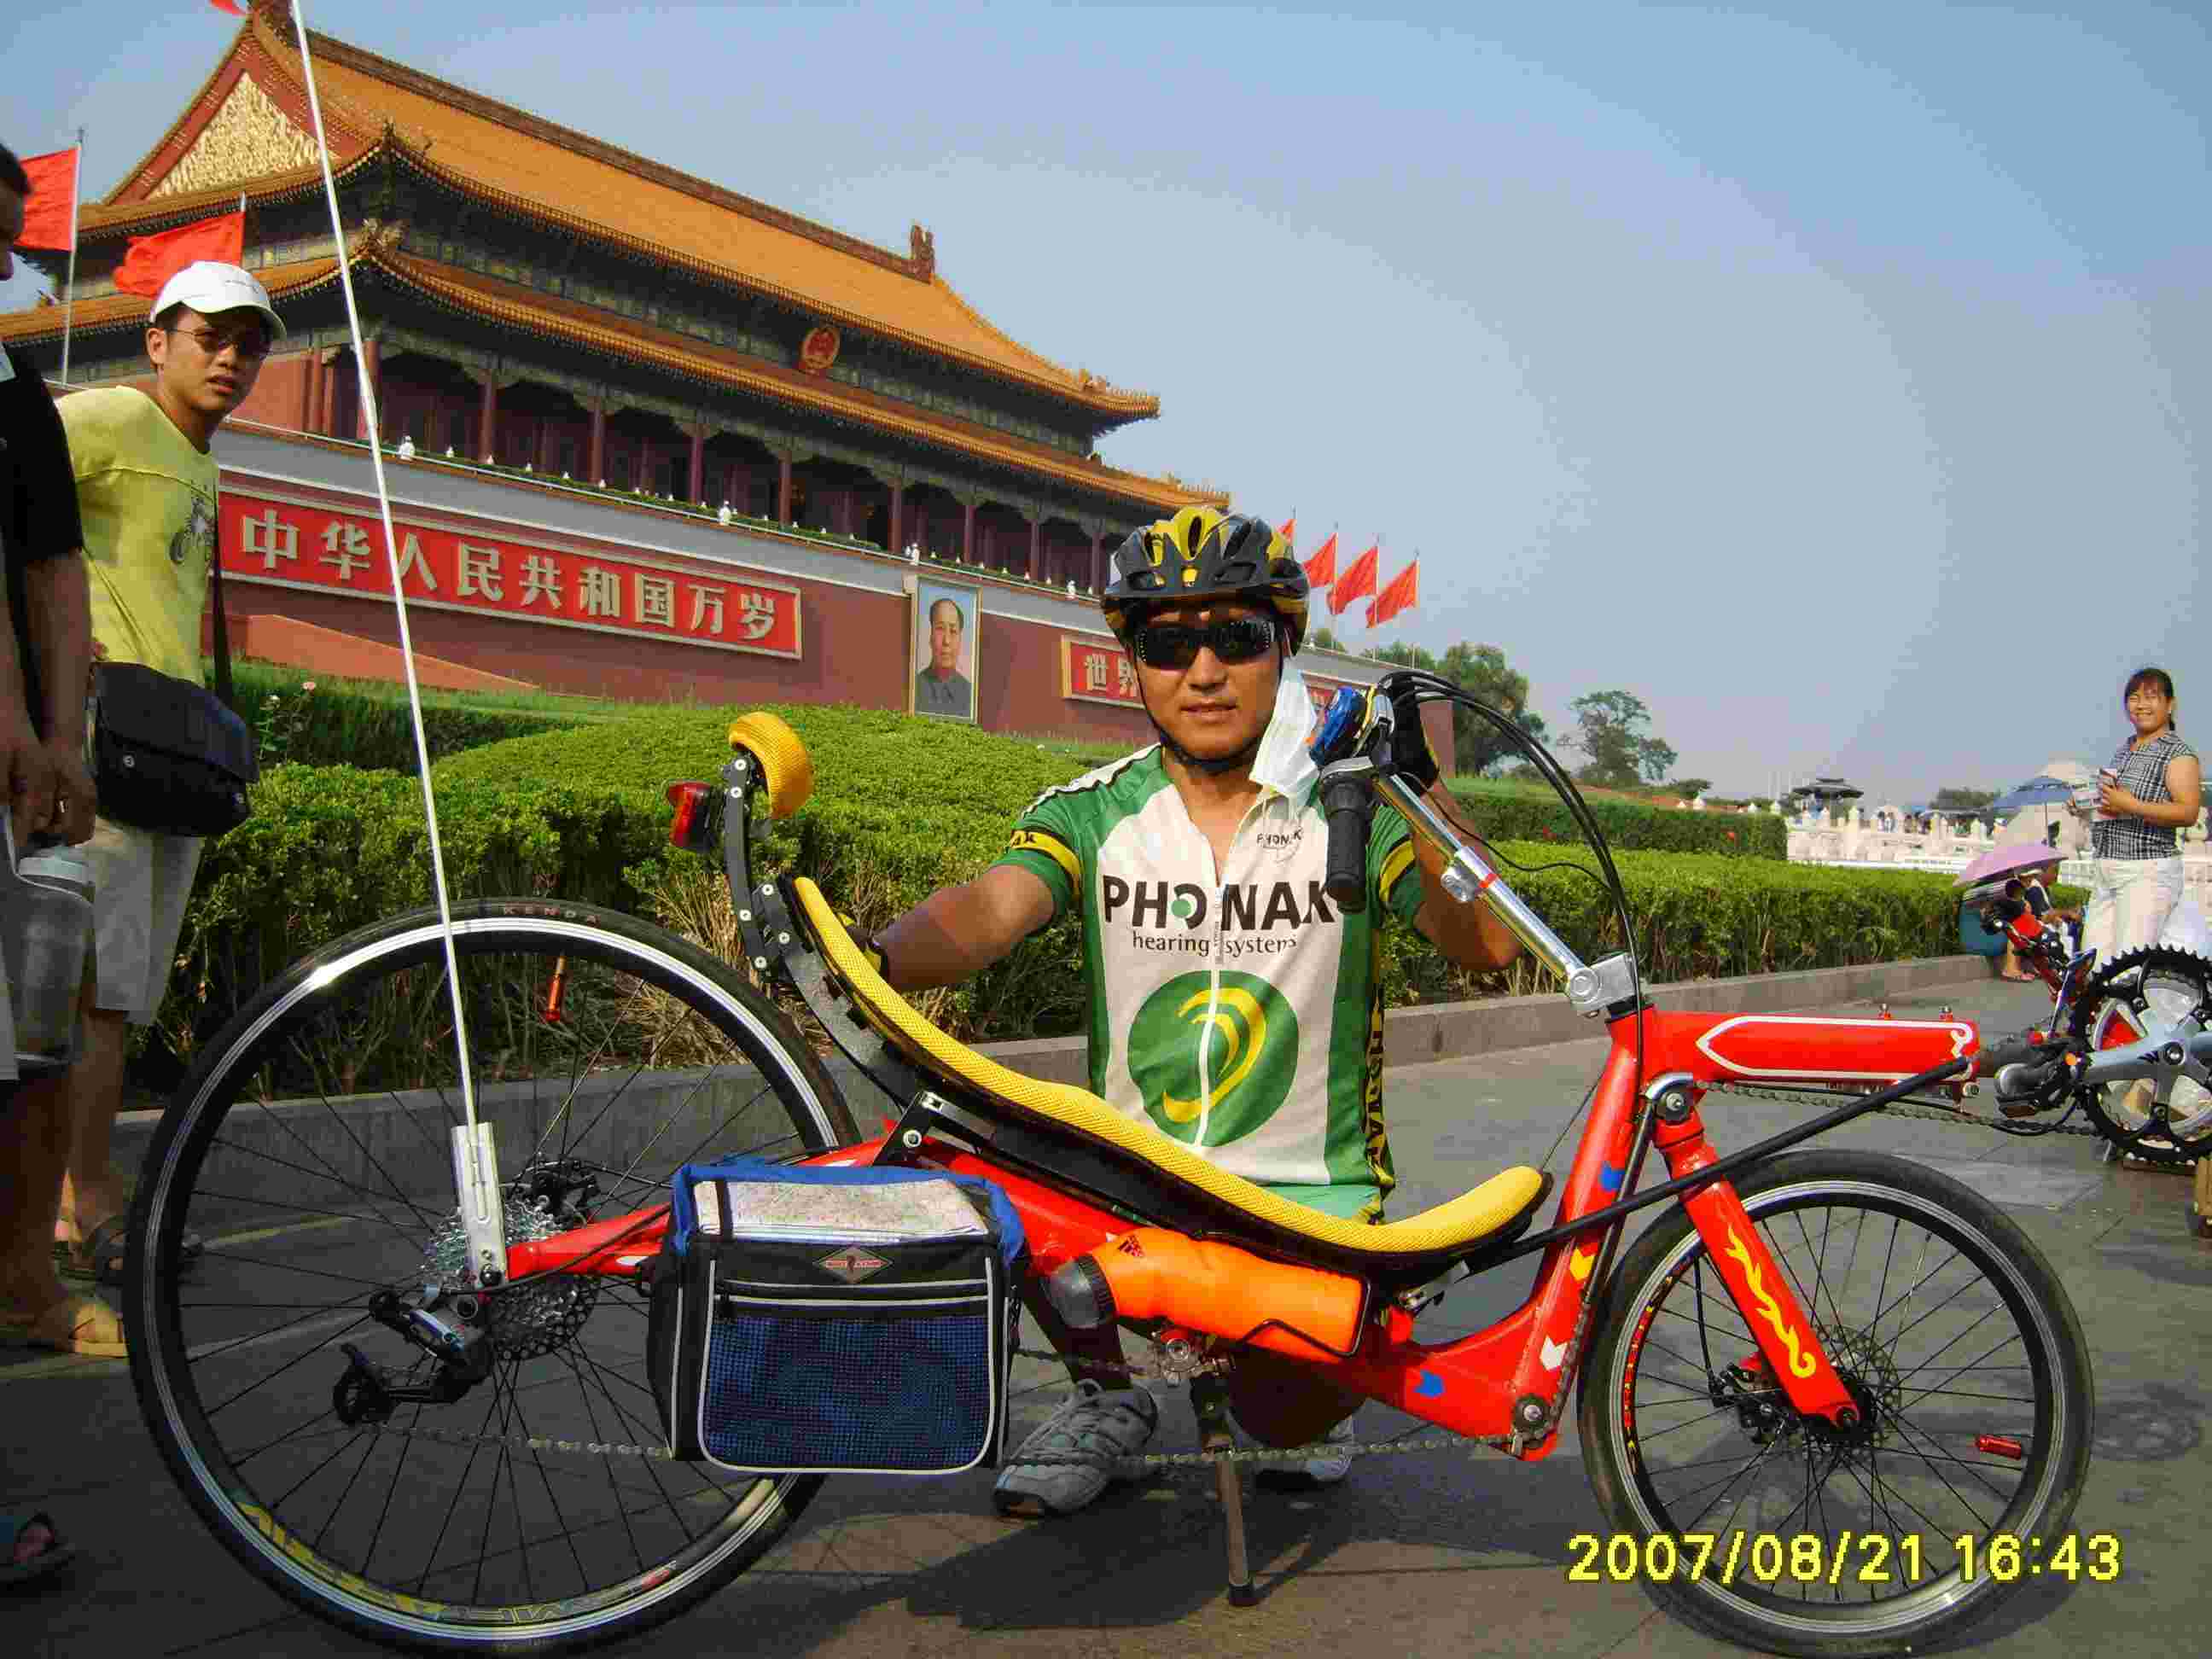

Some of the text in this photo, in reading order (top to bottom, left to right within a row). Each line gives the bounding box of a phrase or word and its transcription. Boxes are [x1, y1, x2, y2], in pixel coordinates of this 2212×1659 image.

[241, 509, 775, 639] 中华人民共和国万岁
[1103, 875, 1336, 931] PHONAK
[1132, 931, 1209, 957] hearing
